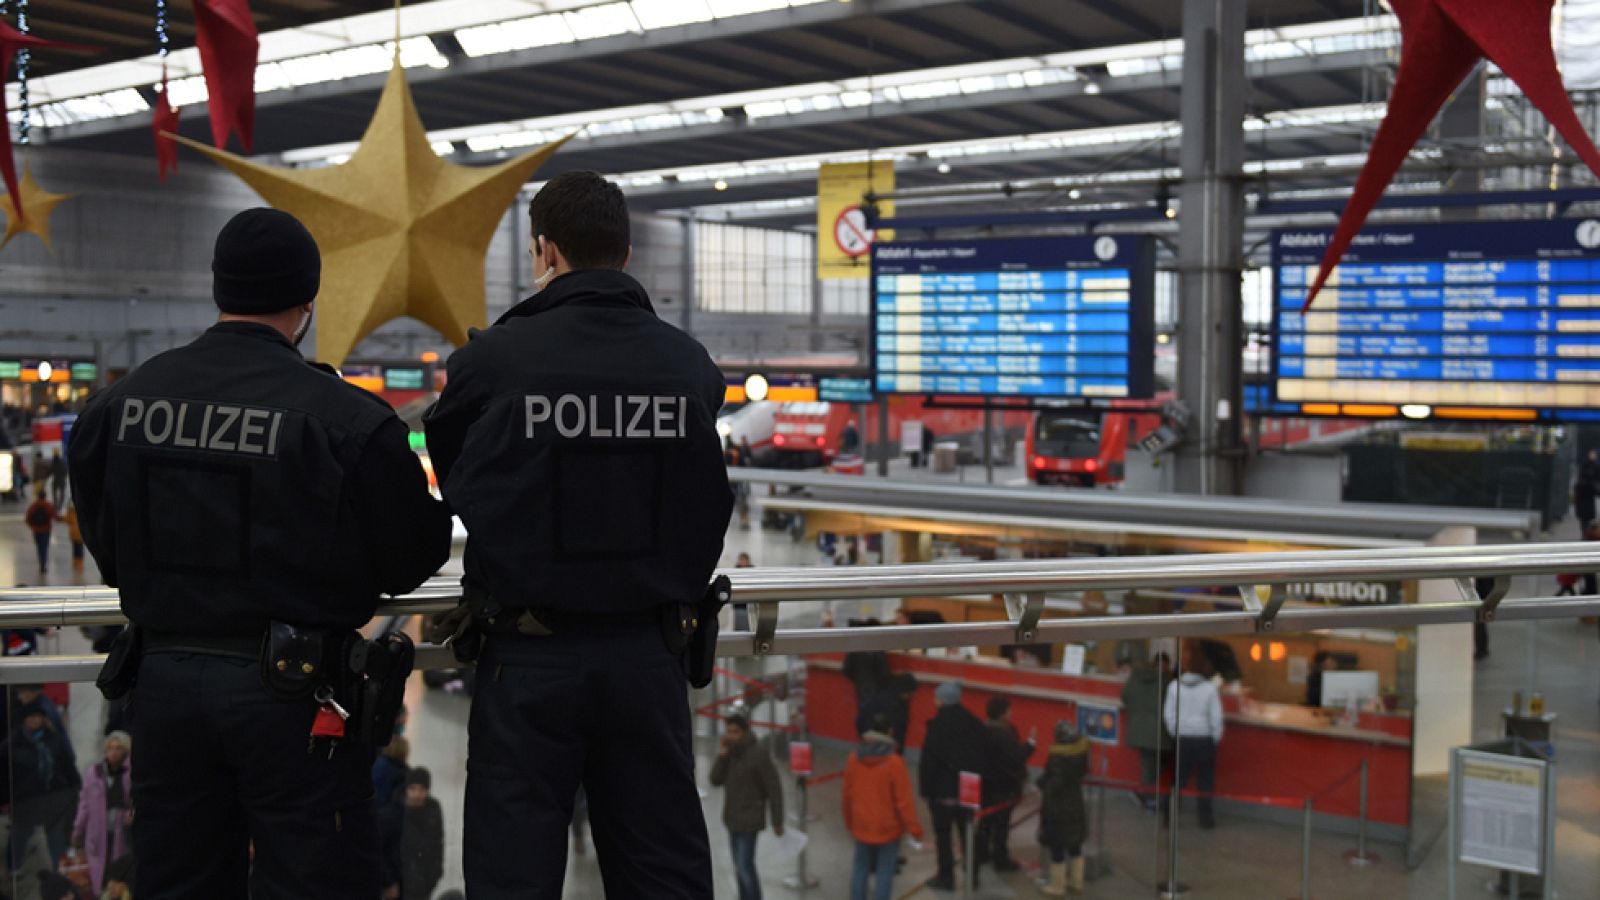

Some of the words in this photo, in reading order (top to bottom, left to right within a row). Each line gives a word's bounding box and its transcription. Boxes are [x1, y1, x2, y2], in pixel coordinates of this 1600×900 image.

[1279, 233, 1326, 247] Abfahrt
[117, 398, 282, 455] POLIZEI
[526, 394, 687, 438] POLIZEI
